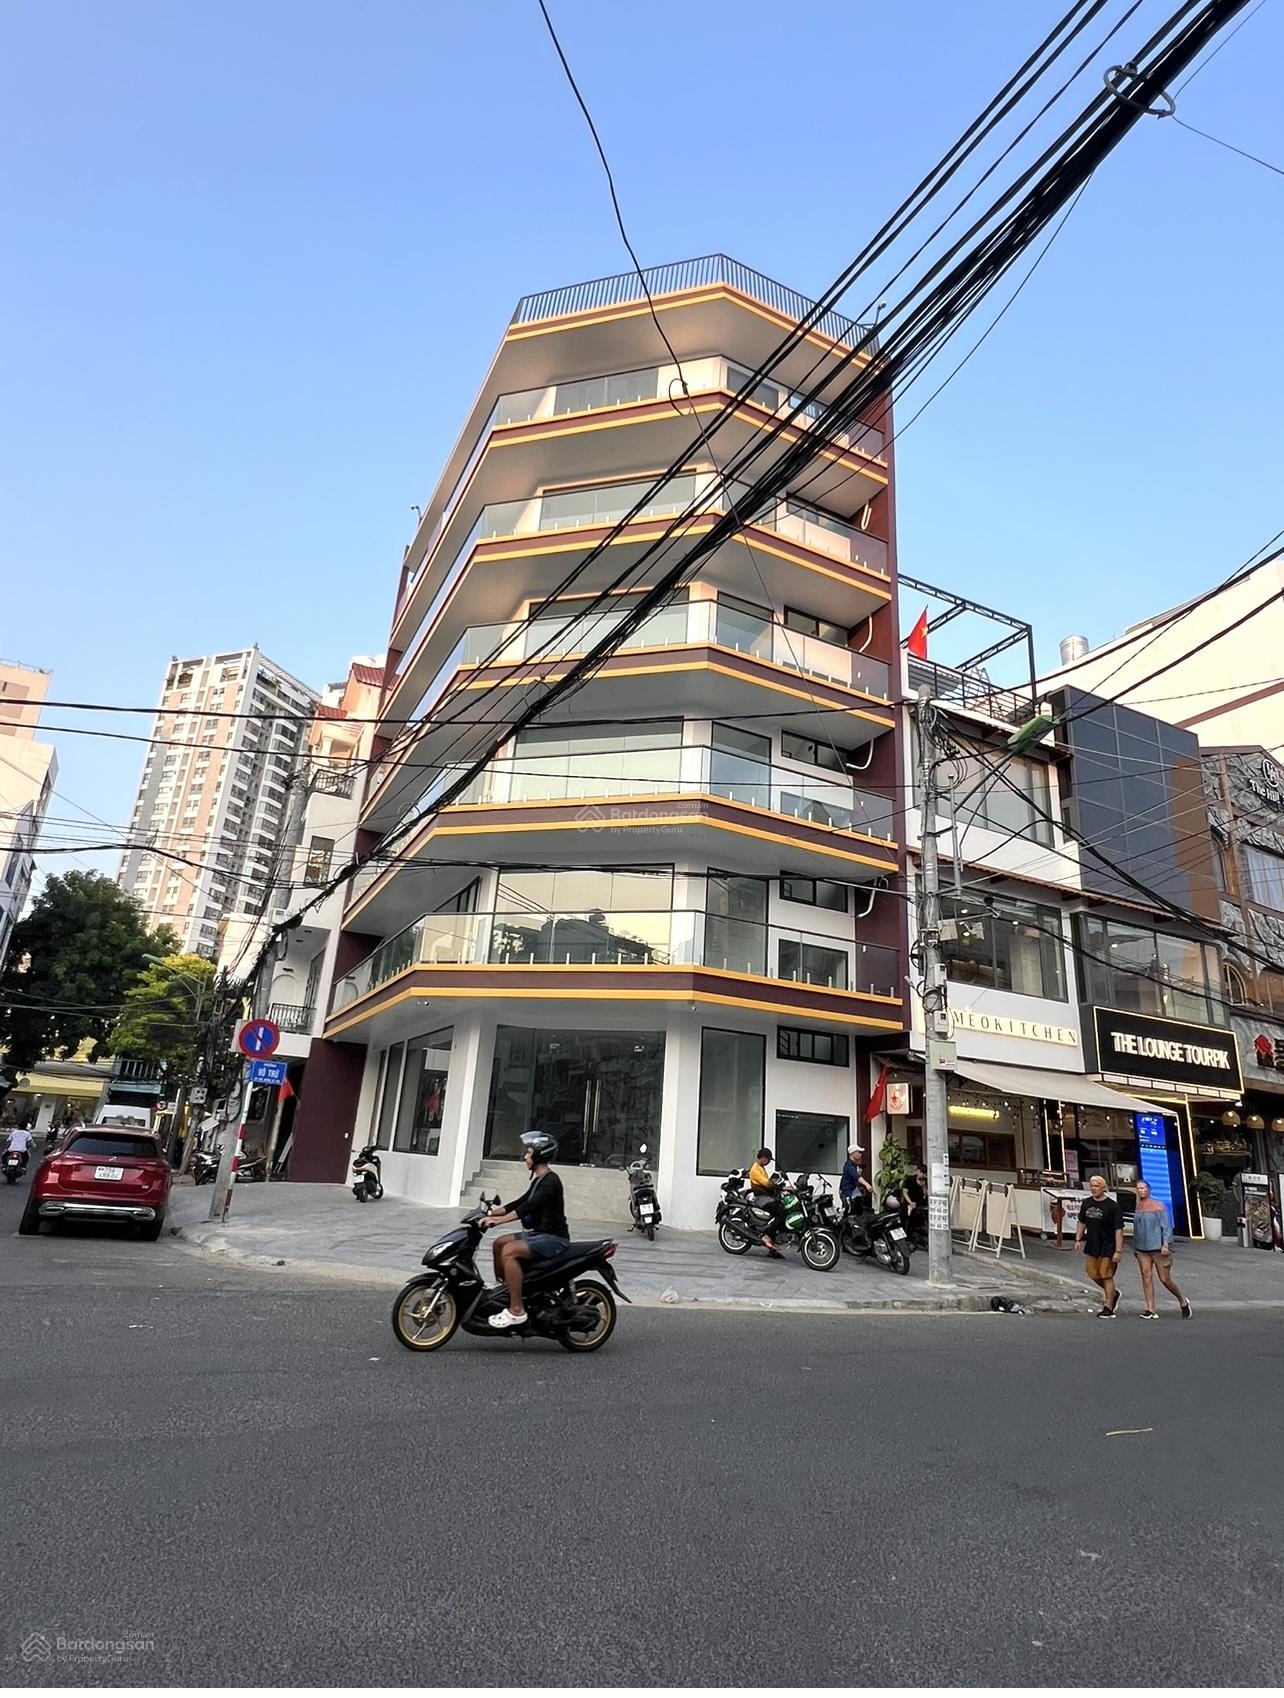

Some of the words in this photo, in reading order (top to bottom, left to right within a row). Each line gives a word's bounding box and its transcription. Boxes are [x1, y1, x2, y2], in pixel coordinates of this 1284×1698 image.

[1249, 779, 1266, 797] The
[1110, 1032, 1137, 1055] THE
[1137, 1036, 1184, 1062] LOUNGE
